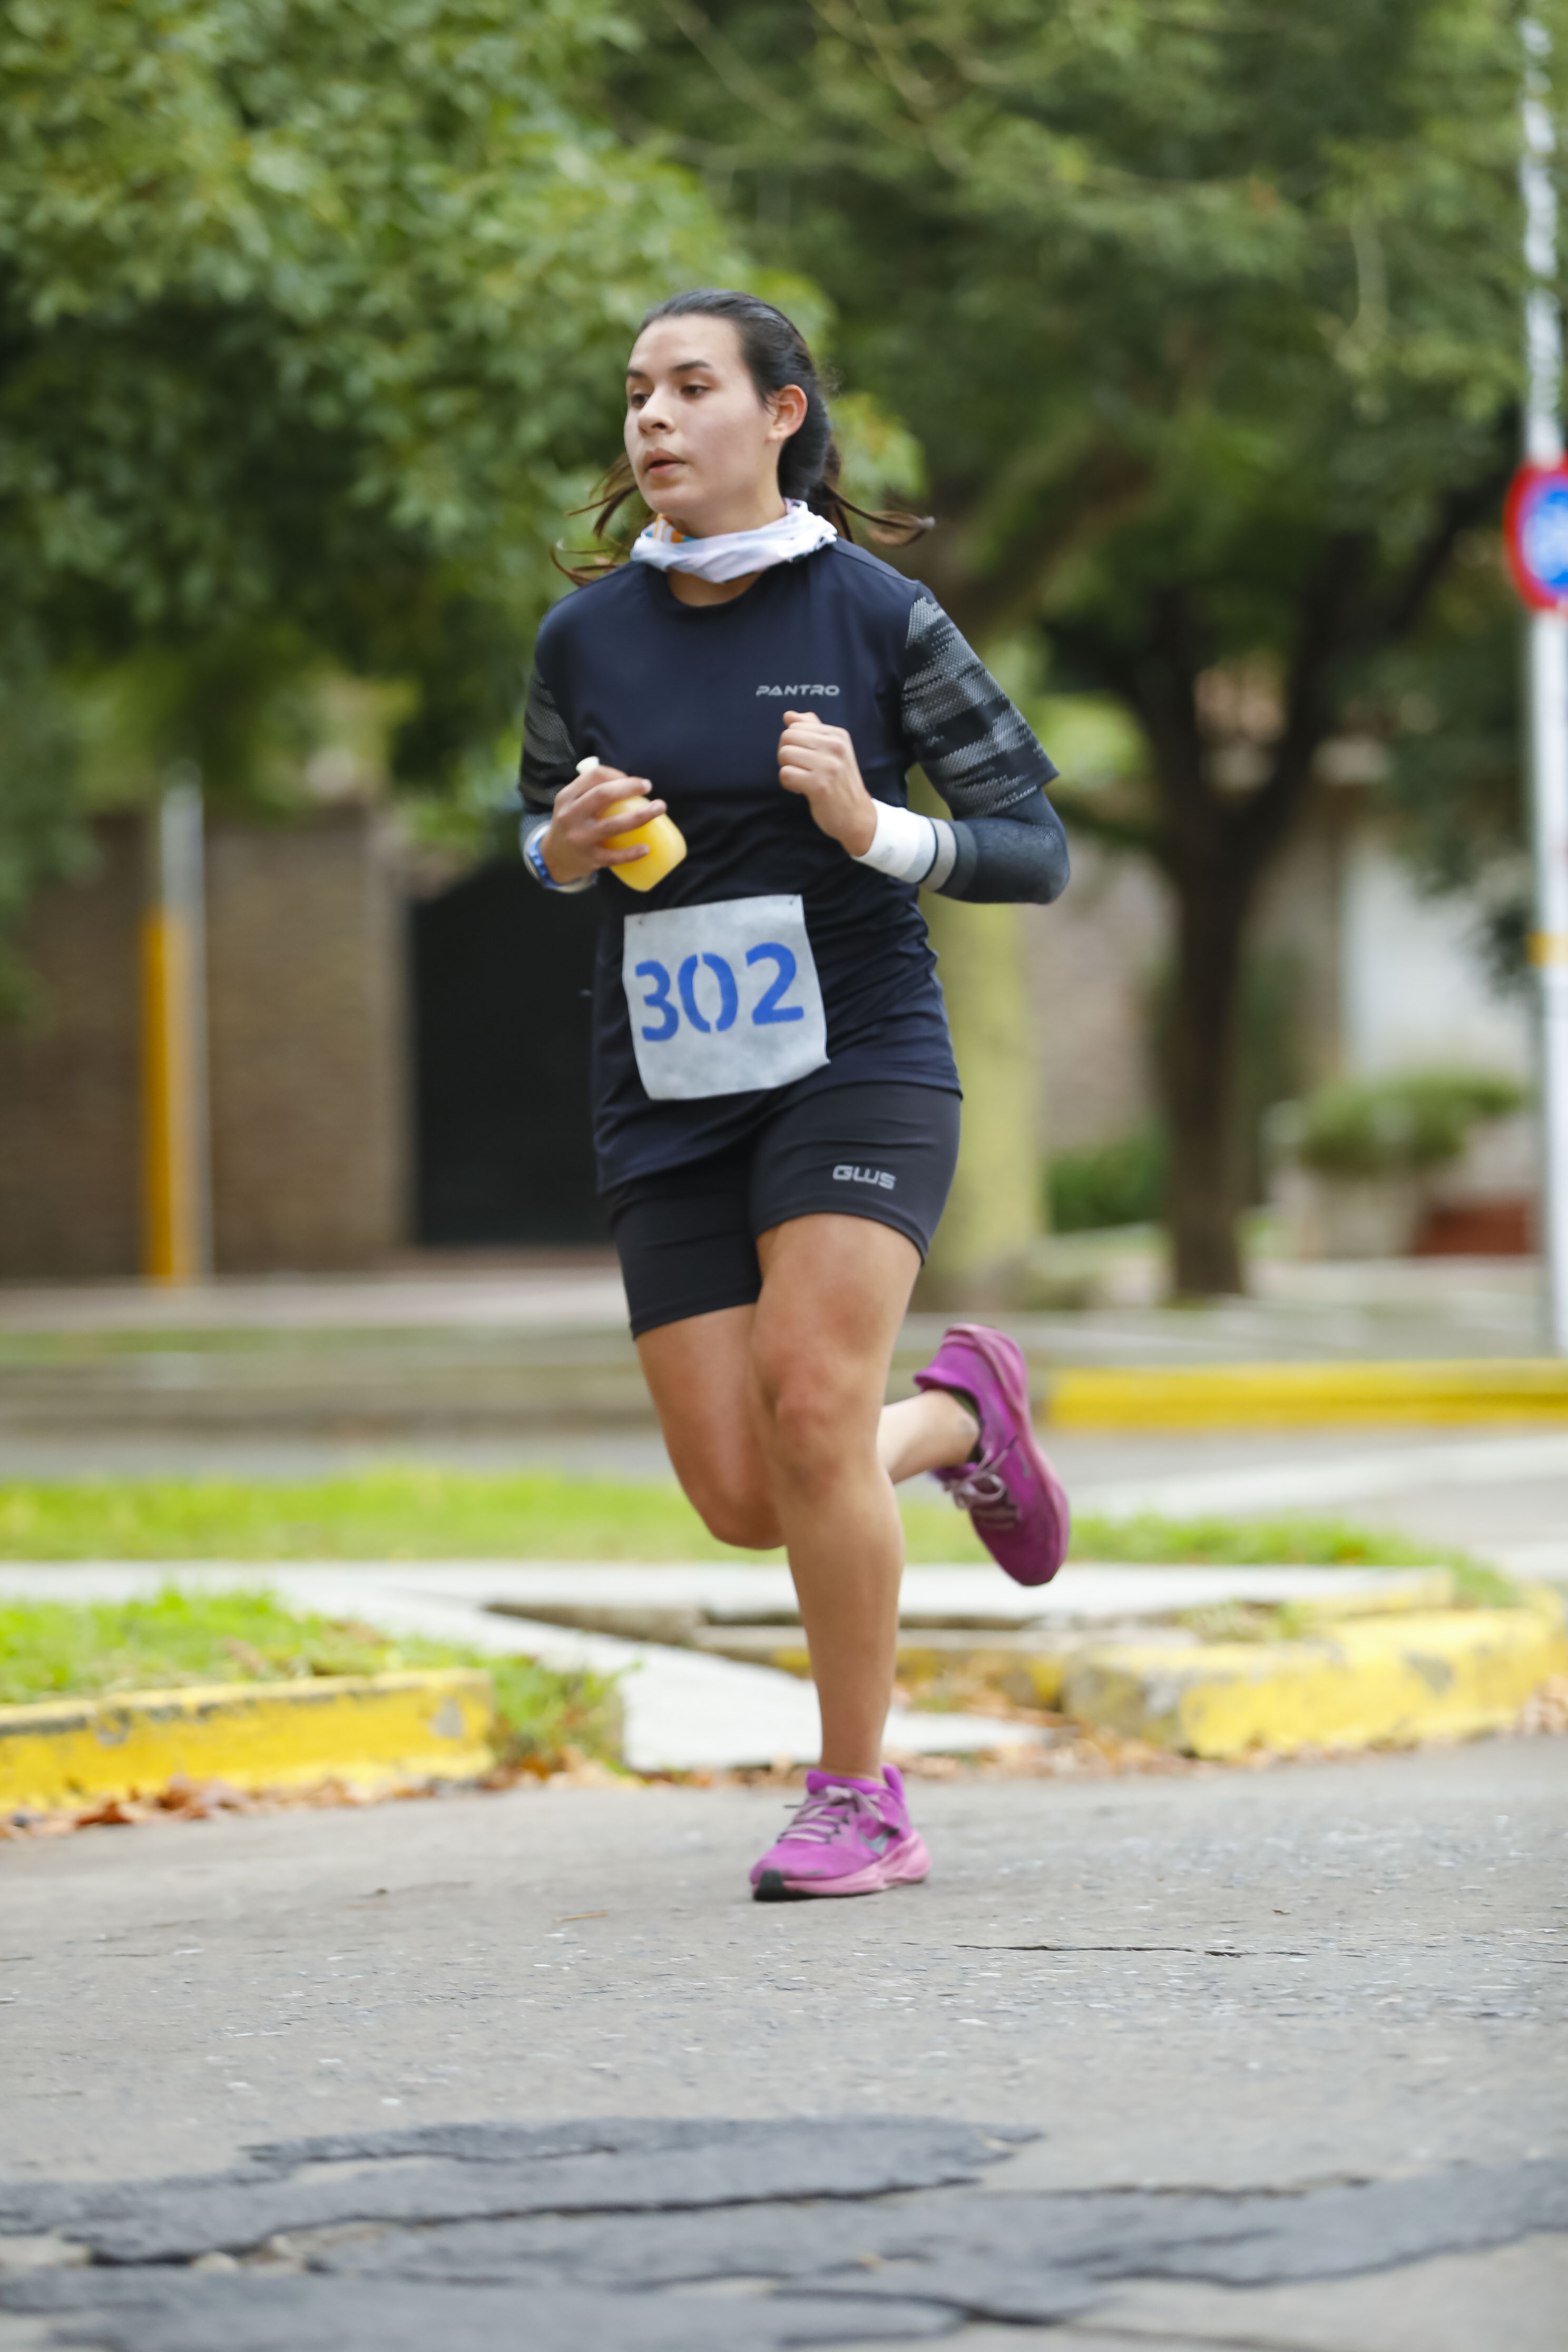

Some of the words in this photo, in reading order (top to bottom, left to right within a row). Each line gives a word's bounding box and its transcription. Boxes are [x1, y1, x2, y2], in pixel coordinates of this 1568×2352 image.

[756, 684, 840, 696] PANTRO
[635, 942, 804, 1042] 302
[832, 1164, 896, 1190] GWS
